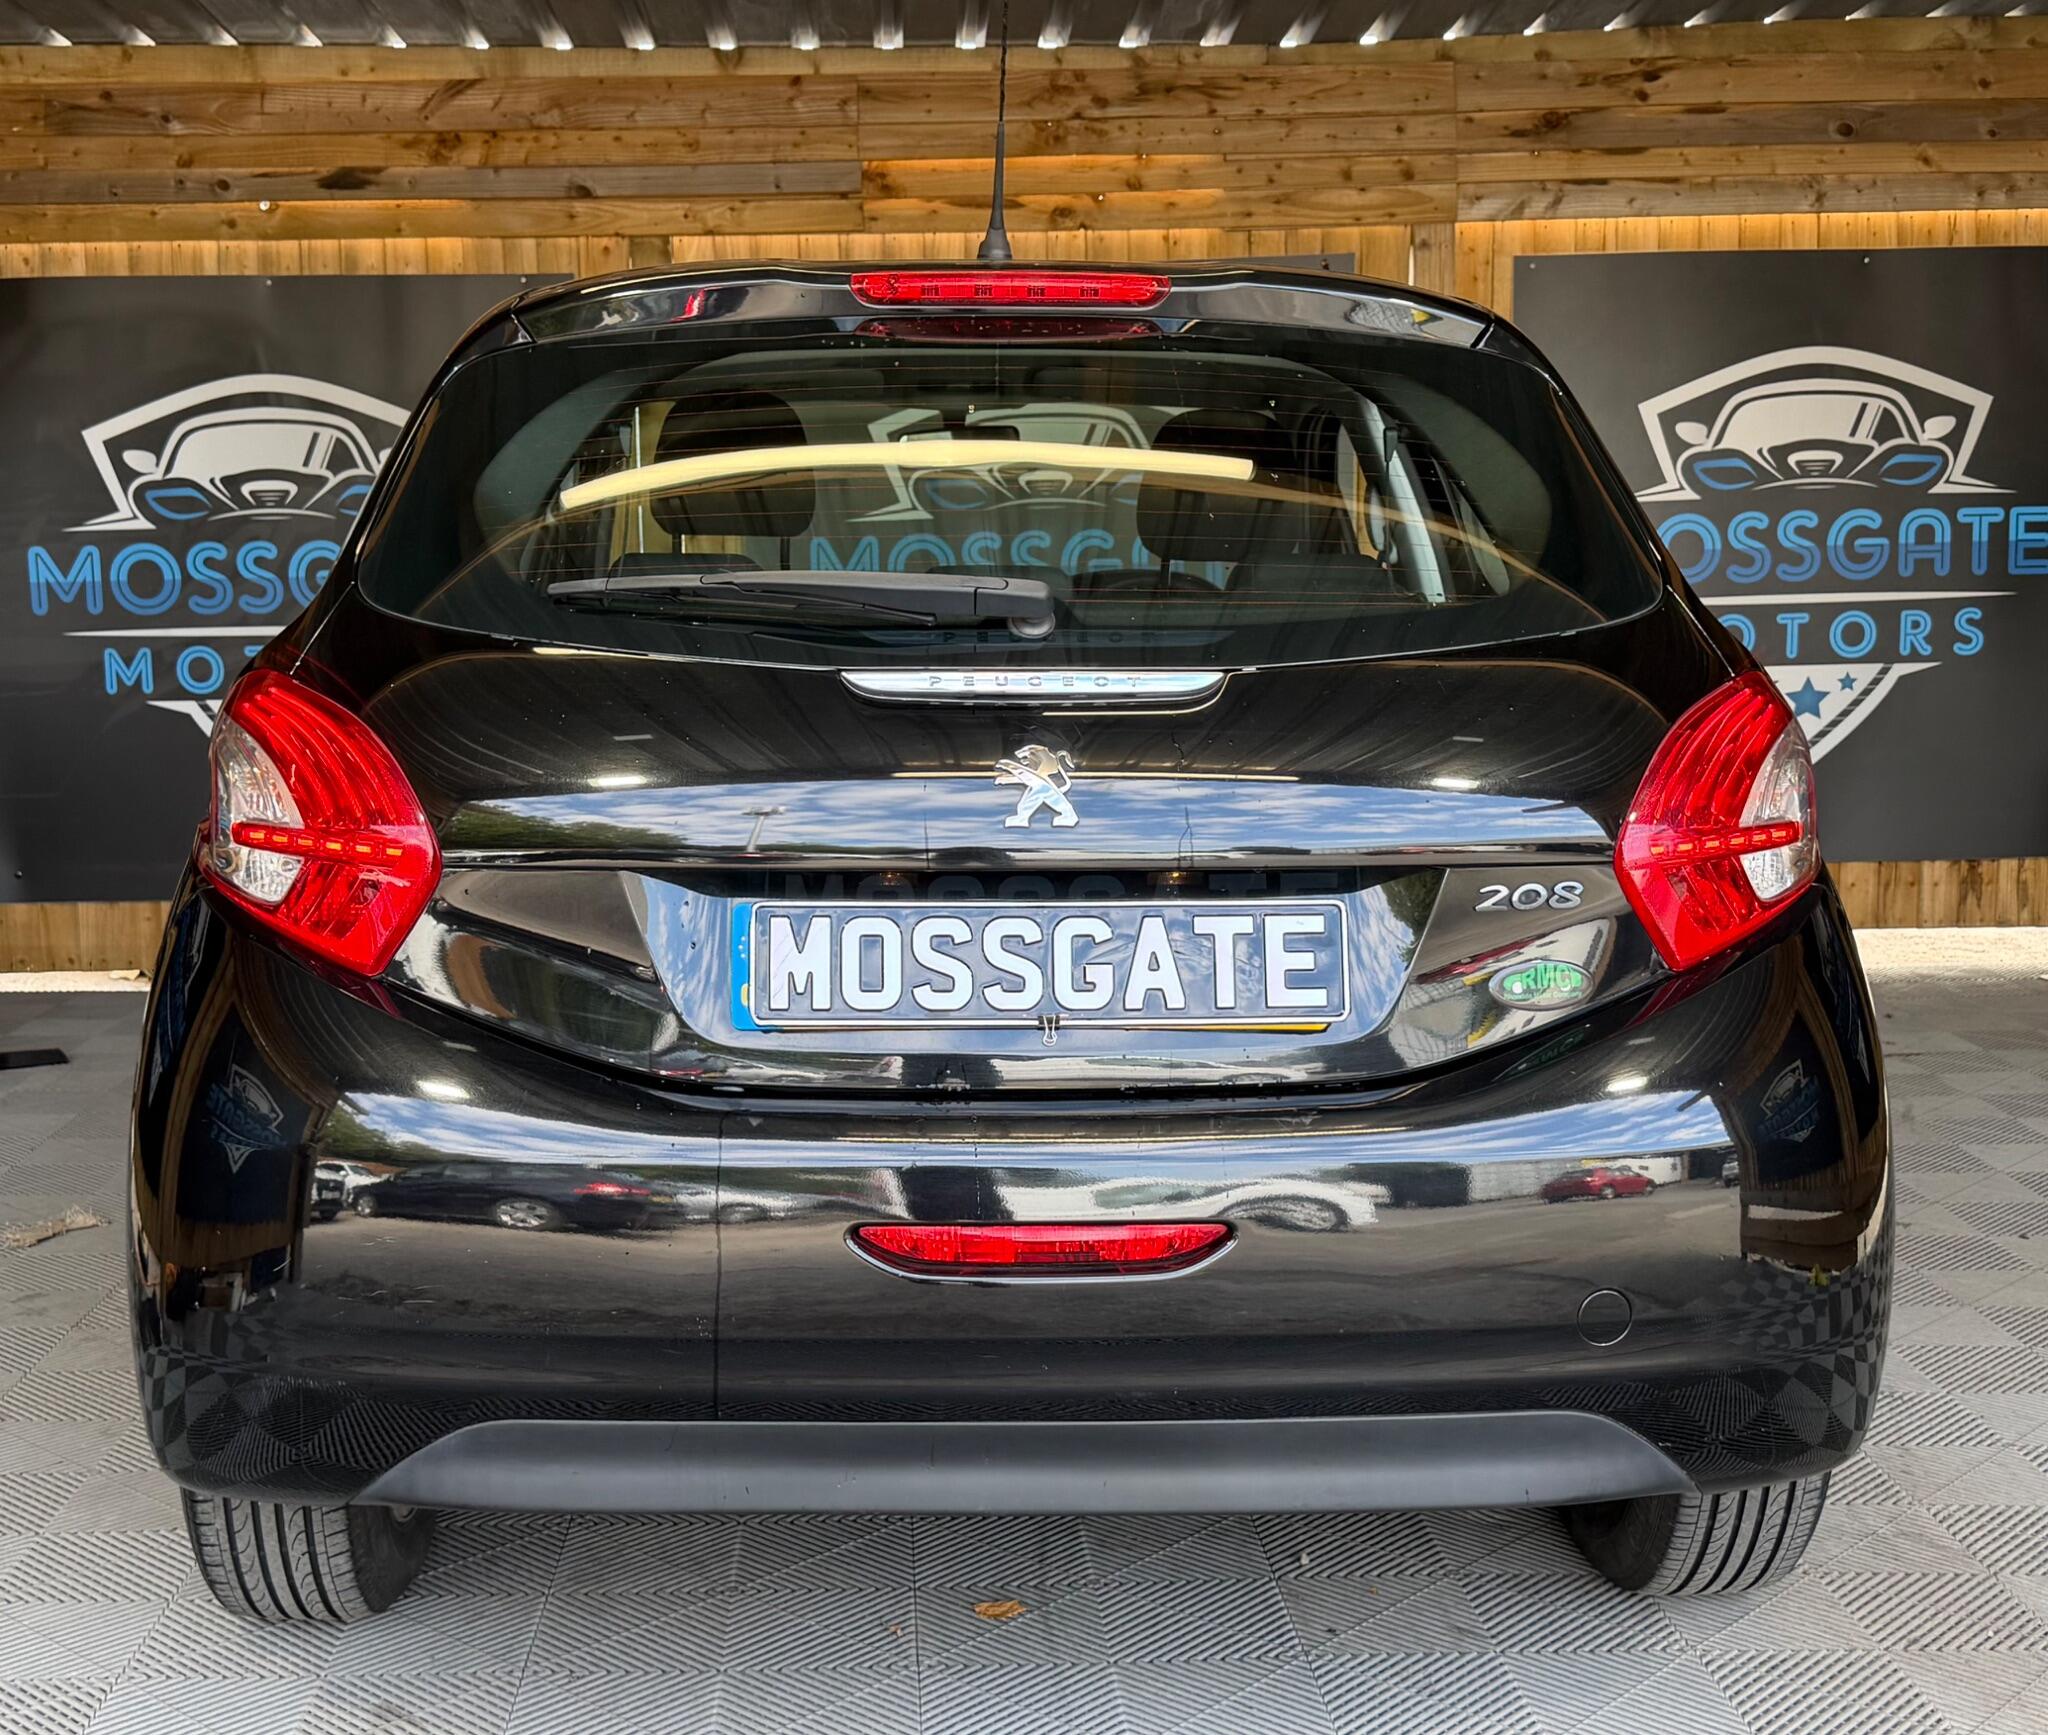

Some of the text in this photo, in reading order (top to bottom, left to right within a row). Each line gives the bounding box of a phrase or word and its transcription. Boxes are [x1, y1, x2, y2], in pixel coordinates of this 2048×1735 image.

[928, 674, 1142, 688] PEUGEOT
[1474, 880, 1585, 912] 208
[767, 913, 1329, 1012] MOSSGATE
